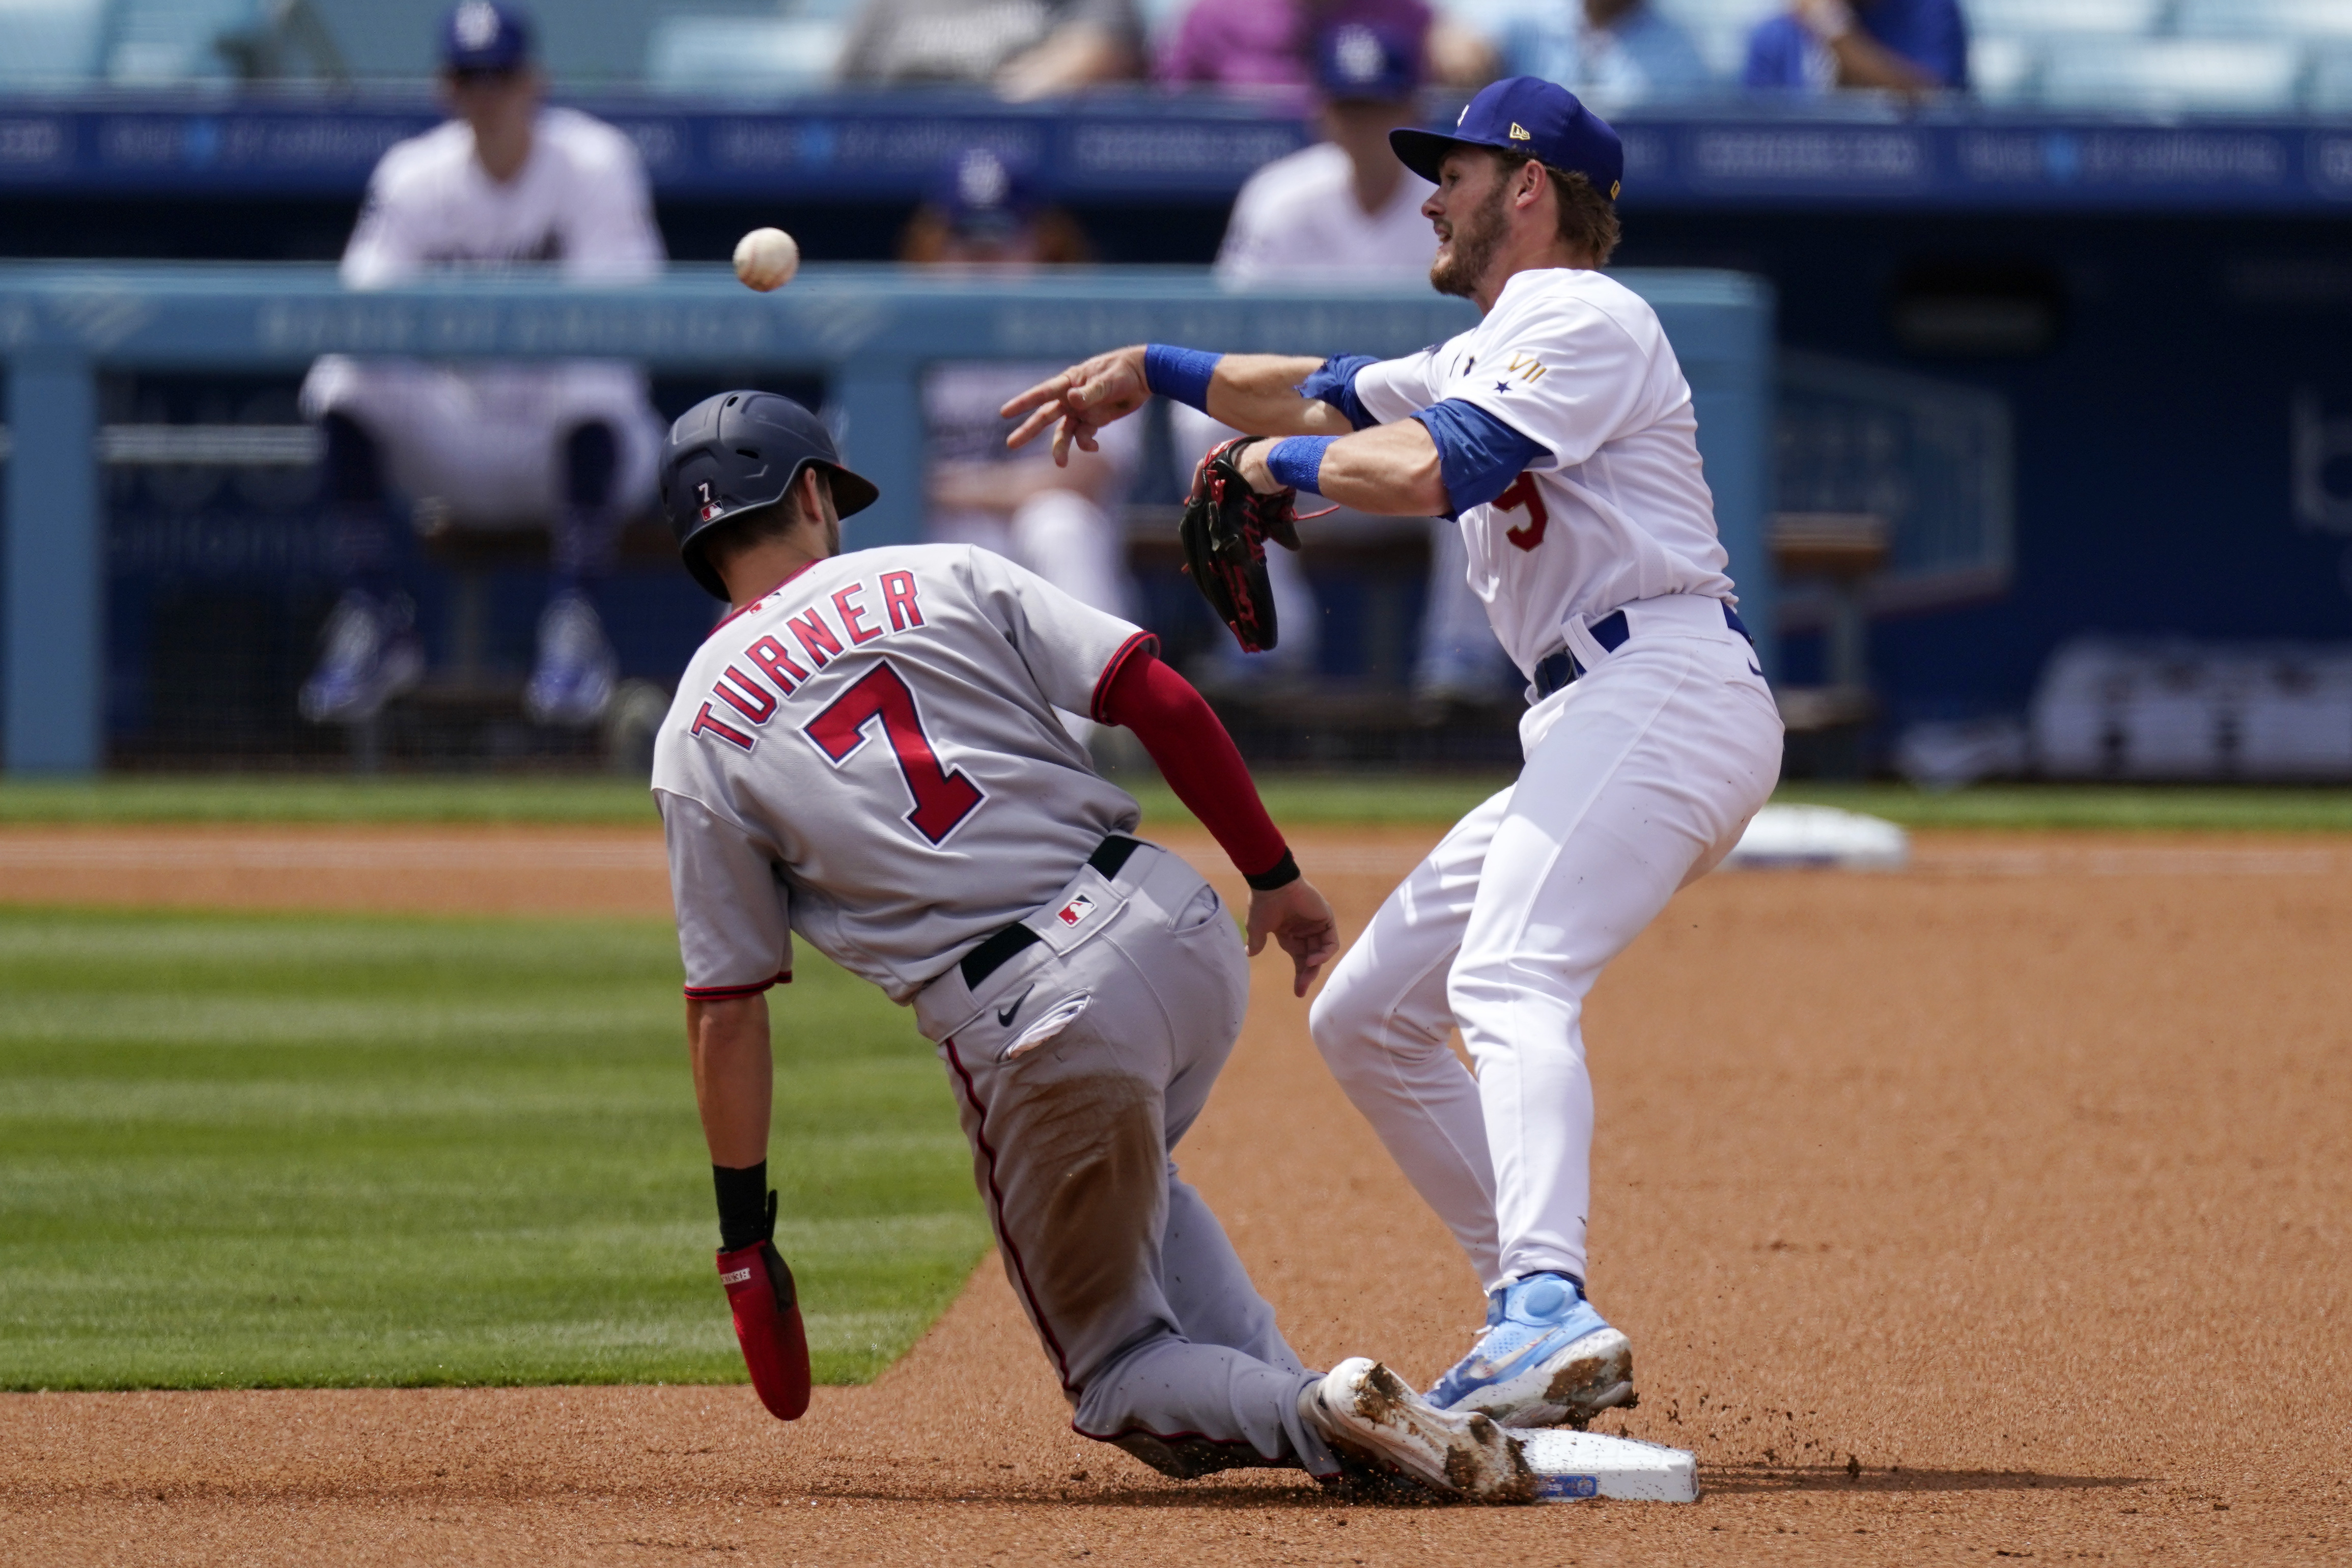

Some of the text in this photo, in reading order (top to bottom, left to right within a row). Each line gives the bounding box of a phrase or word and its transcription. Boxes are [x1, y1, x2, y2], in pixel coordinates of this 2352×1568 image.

[1508, 353, 1547, 383] VII
[698, 483, 710, 503] 7
[1491, 471, 1549, 552] 9
[690, 569, 928, 752] TURNER
[799, 657, 990, 849] 7
